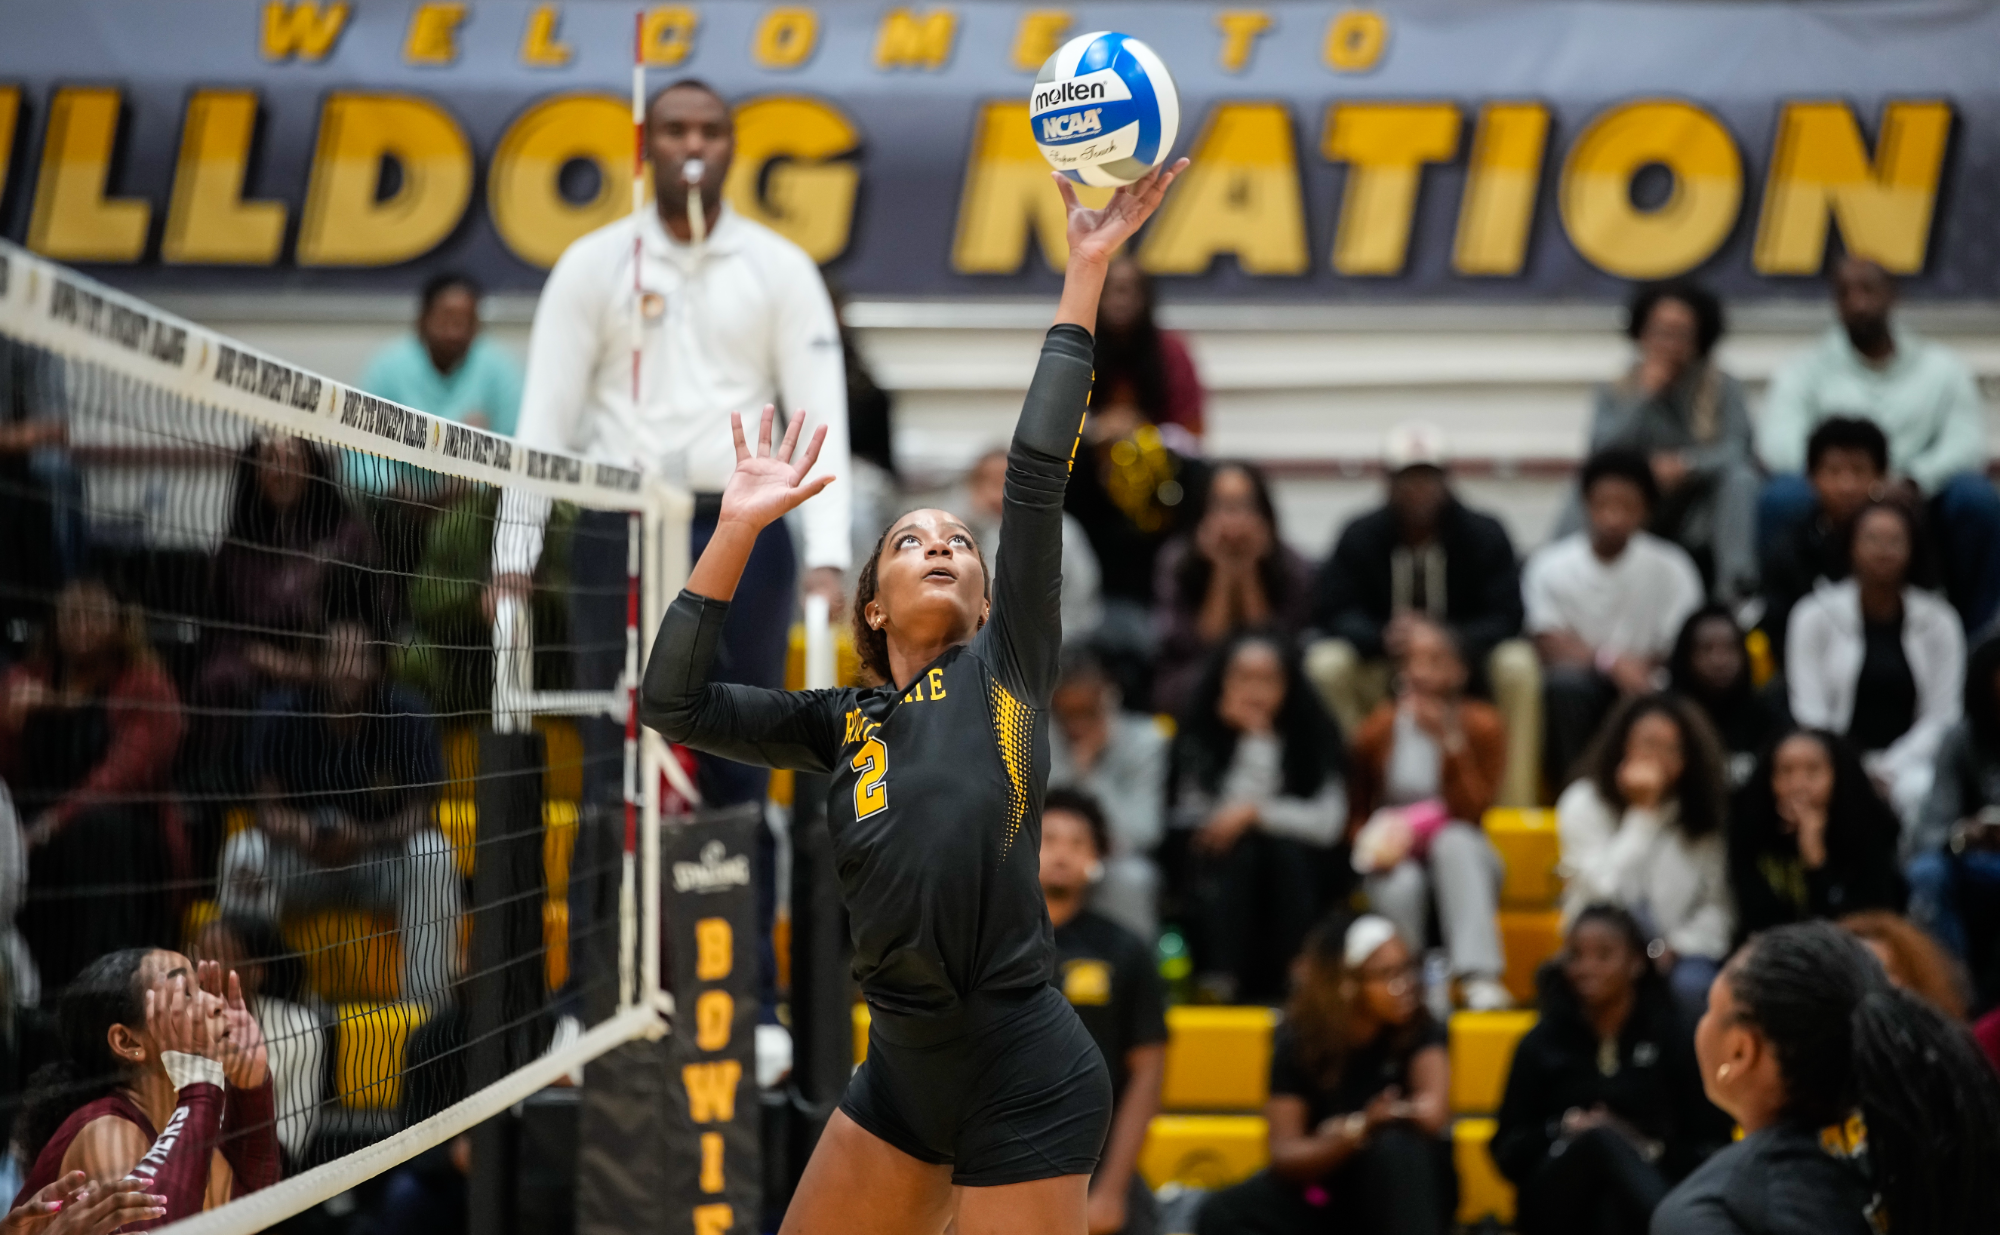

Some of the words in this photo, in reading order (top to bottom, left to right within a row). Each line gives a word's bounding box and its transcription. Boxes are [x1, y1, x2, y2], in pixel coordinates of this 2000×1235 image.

[260, 2, 1073, 69] WELCOME
[1217, 12, 1388, 71] TO
[1036, 81, 1105, 112] molten
[1042, 108, 1101, 139] NCAA
[0, 87, 861, 267] LLDOG
[850, 735, 888, 822] 2
